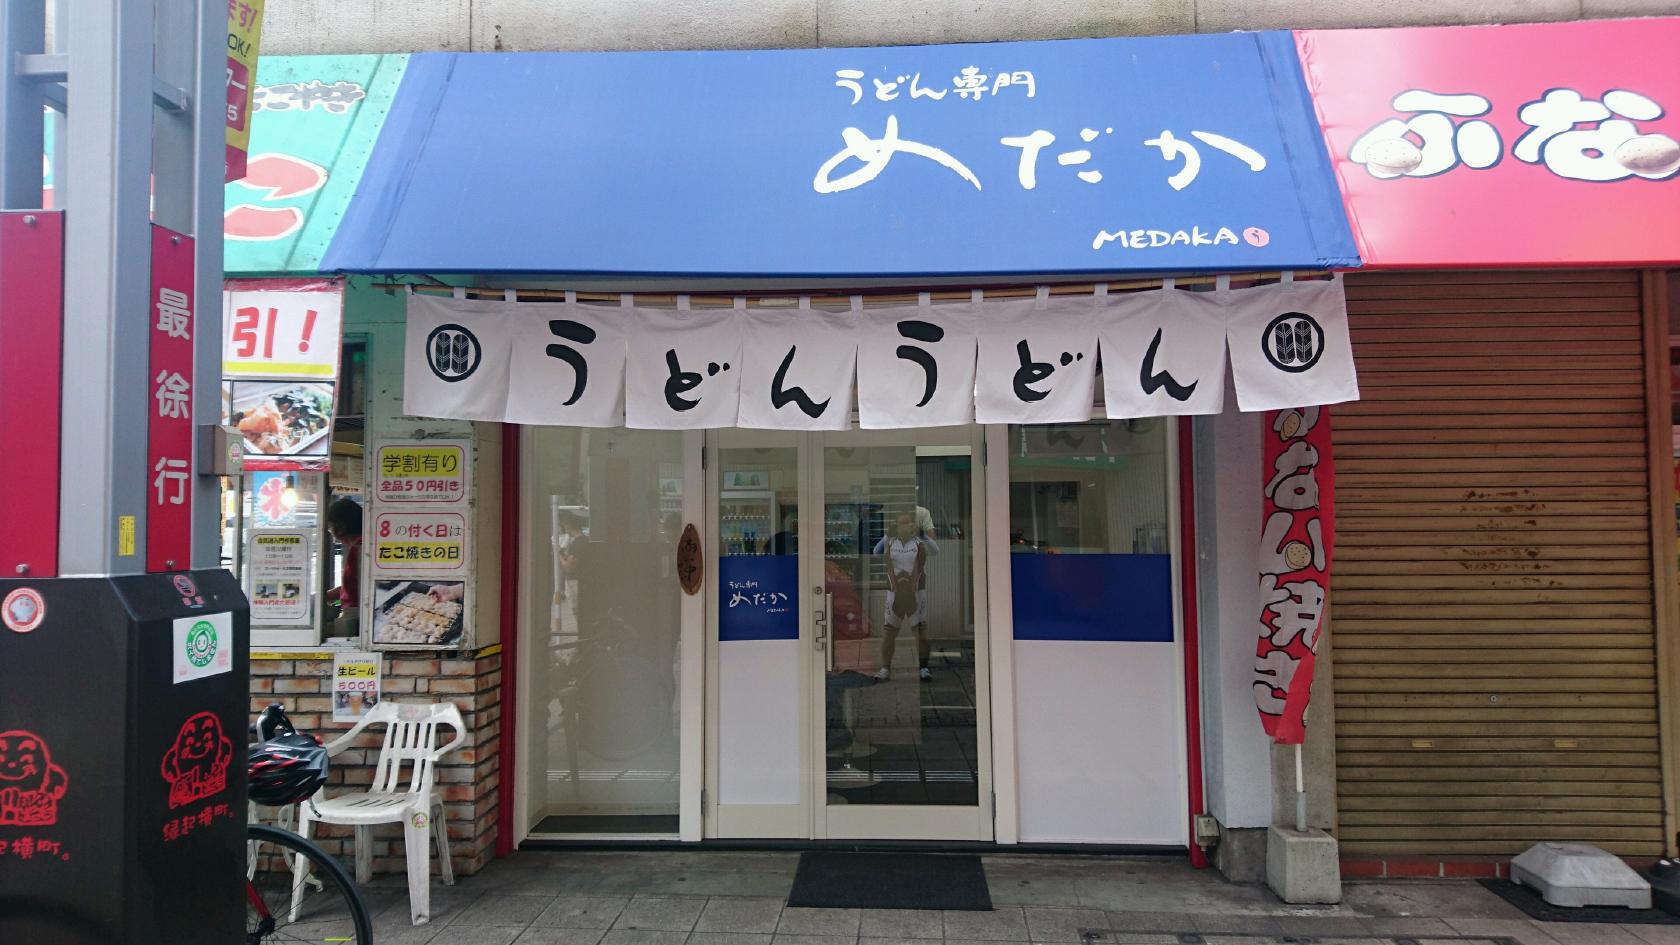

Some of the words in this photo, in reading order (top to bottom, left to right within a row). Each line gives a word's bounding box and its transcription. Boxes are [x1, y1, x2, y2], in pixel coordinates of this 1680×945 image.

[227, 33, 251, 58] OK!
[835, 66, 1036, 105] うどん専門
[813, 114, 1267, 194] めだか
[1092, 226, 1239, 250] MEDAKA
[154, 287, 191, 505] 最徐行
[383, 454, 458, 473] 学割有り
[381, 480, 460, 492] 全品50円引き
[379, 520, 462, 538] 8の付く日は
[379, 545, 460, 560] たこ焼きの日
[728, 591, 788, 608] めだか
[337, 666, 376, 677] 生ビール
[338, 680, 376, 690] 500円
